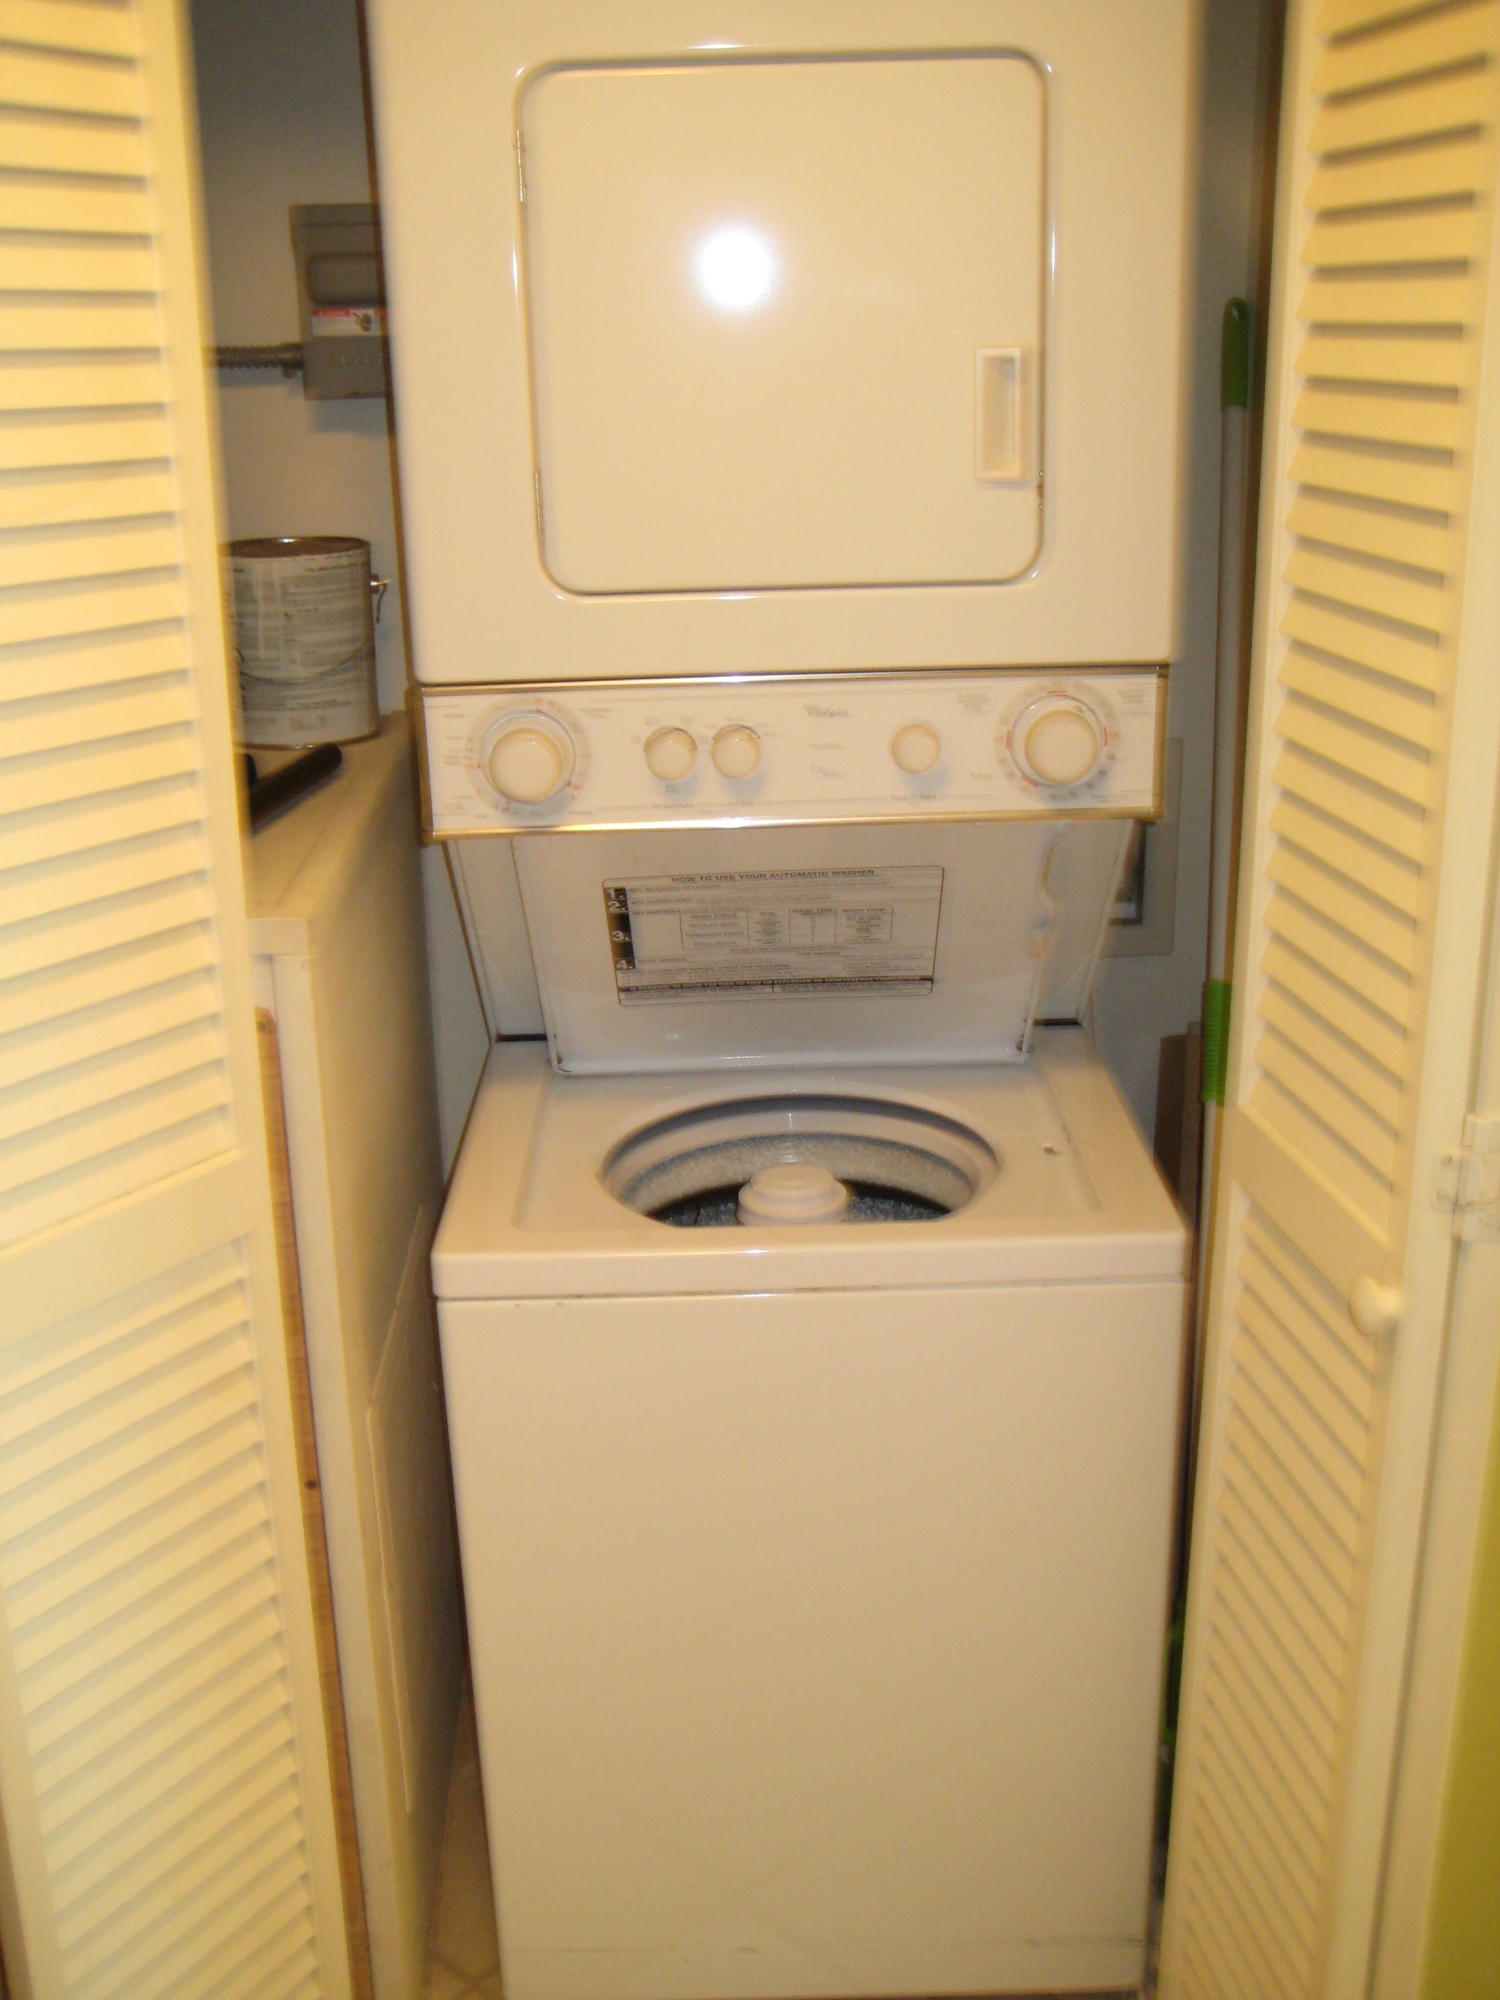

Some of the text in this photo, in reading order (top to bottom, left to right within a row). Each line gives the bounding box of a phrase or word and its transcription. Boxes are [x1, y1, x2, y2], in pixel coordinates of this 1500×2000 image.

[671, 868, 876, 883] HOW TO USE YOUR AUTOMATIC WASHER
[608, 886, 626, 901] 1.
[607, 900, 628, 913] 2.
[611, 930, 632, 943] 3.
[616, 958, 635, 970] 4.
